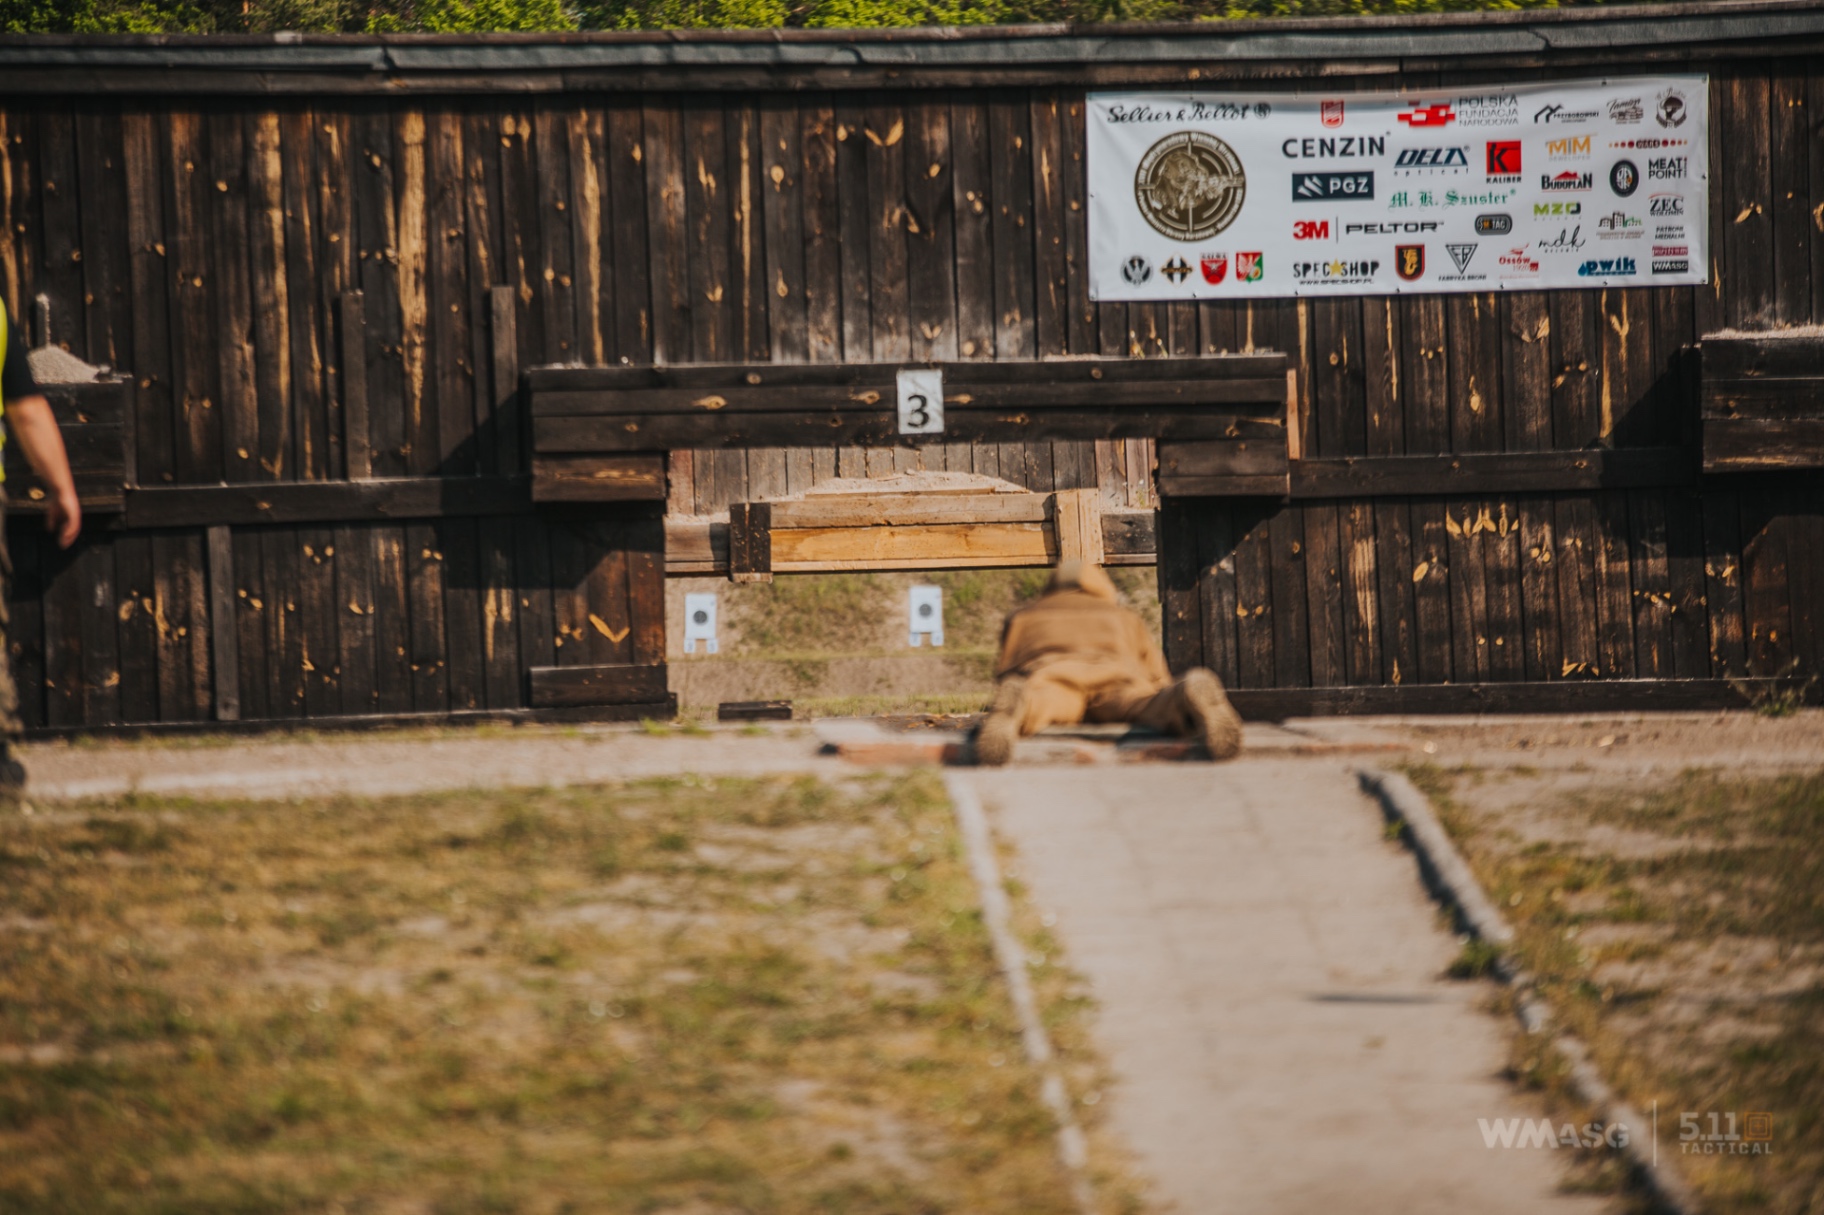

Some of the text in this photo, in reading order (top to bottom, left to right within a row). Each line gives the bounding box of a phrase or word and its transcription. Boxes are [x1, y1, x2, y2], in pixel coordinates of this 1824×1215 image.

[1459, 95, 1518, 109] POLSKA
[1107, 101, 1250, 124] Sellier & Bellot
[1459, 109, 1518, 118] FUNDACJA
[1459, 119, 1518, 127] NARODOWA
[1282, 136, 1385, 158] CENZIN
[1649, 157, 1682, 170] MEAT
[1649, 170, 1682, 180] POINT
[1330, 177, 1369, 194] PGZ
[1650, 197, 1684, 211] ZEC
[1293, 220, 1438, 240] 3M PELTOR
[907, 394, 930, 428] 3
